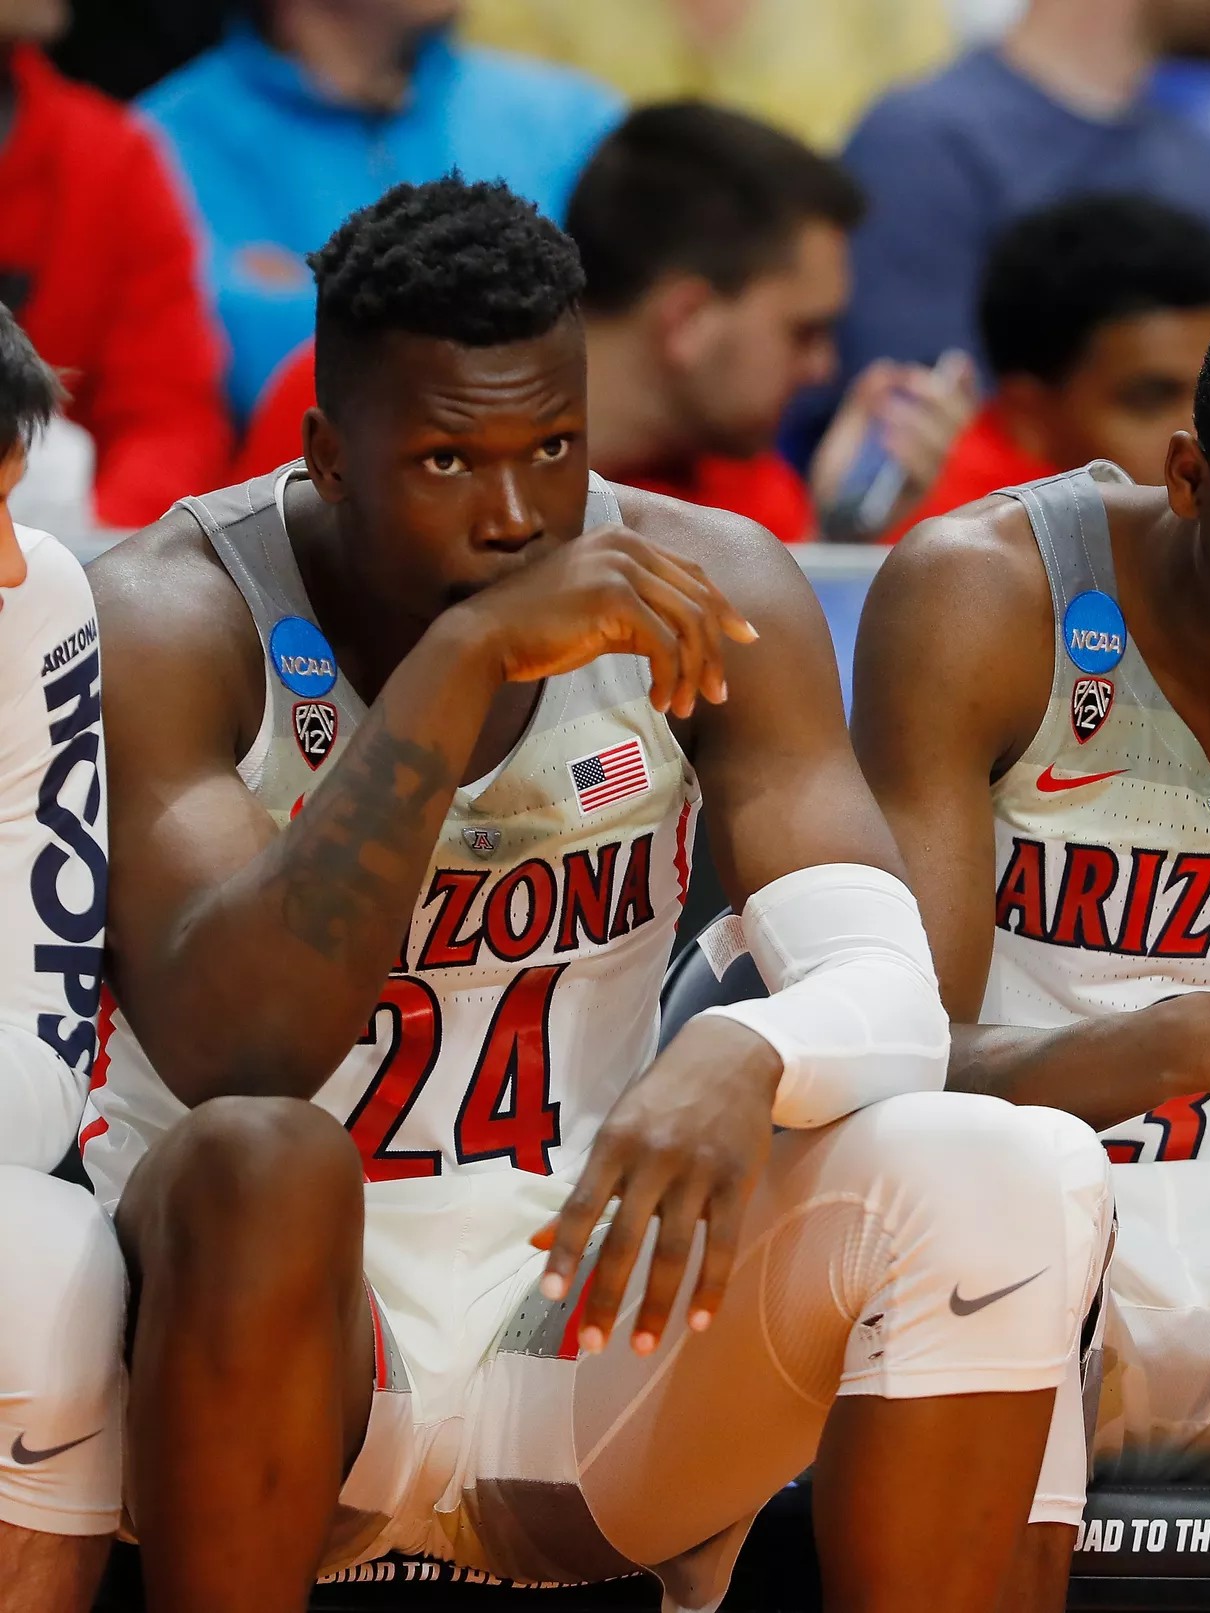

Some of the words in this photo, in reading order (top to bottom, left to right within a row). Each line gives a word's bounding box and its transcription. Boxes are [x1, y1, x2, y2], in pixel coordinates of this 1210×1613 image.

[41, 617, 97, 677] ARIZONA
[1071, 629, 1122, 654] NCAA
[280, 654, 334, 677] NCAA
[1074, 680, 1111, 718] PAC
[295, 704, 334, 741] PAC
[1076, 705, 1096, 730] 12
[304, 730, 326, 754] 12
[385, 832, 655, 973] ZONA
[344, 962, 571, 1180] 24
[1073, 1519, 1125, 1553] AD
[1131, 1519, 1168, 1552] TO
